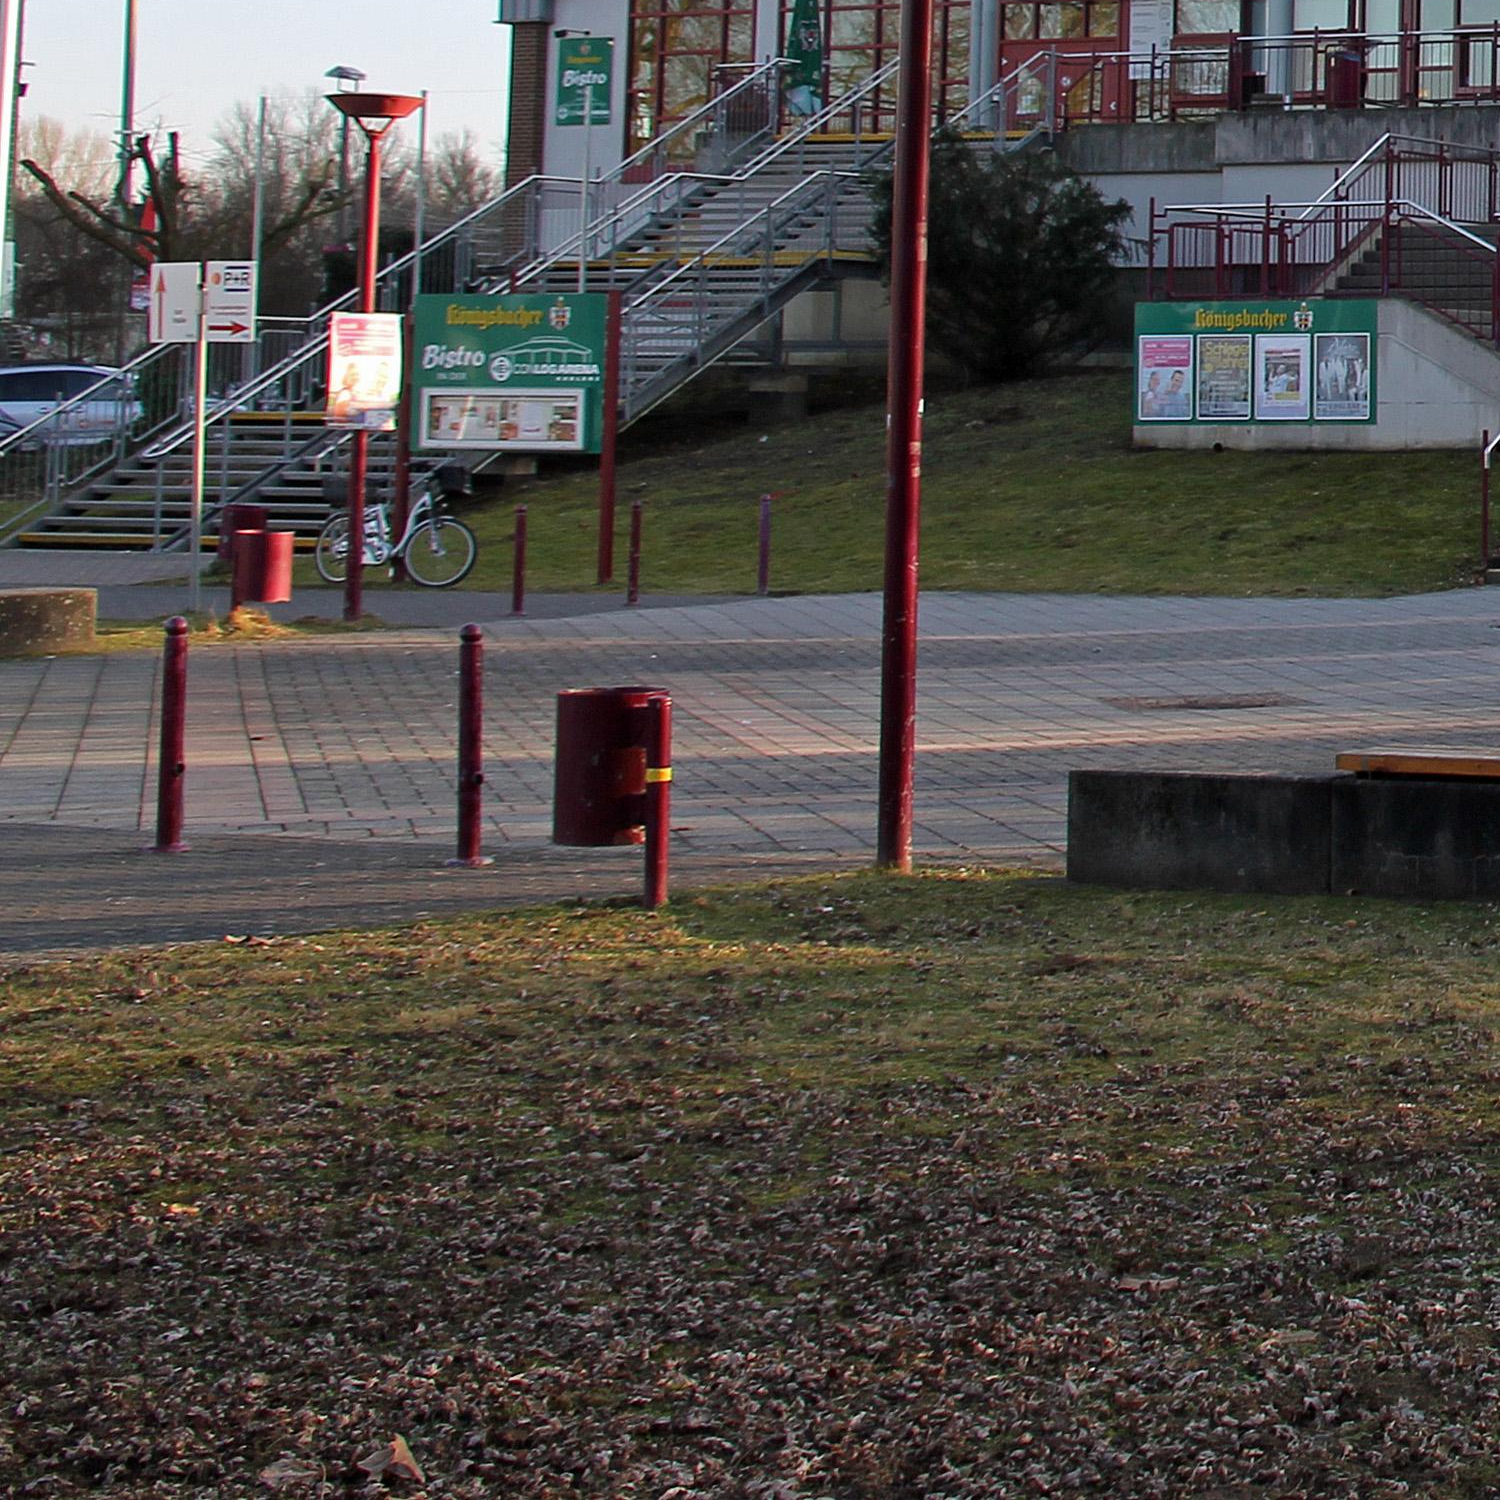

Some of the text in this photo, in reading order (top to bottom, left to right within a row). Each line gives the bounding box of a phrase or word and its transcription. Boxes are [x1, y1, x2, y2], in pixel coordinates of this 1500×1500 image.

[562, 69, 607, 87] Bistro
[1196, 308, 1288, 331] Königsbacher
[422, 344, 487, 370] Bistro
